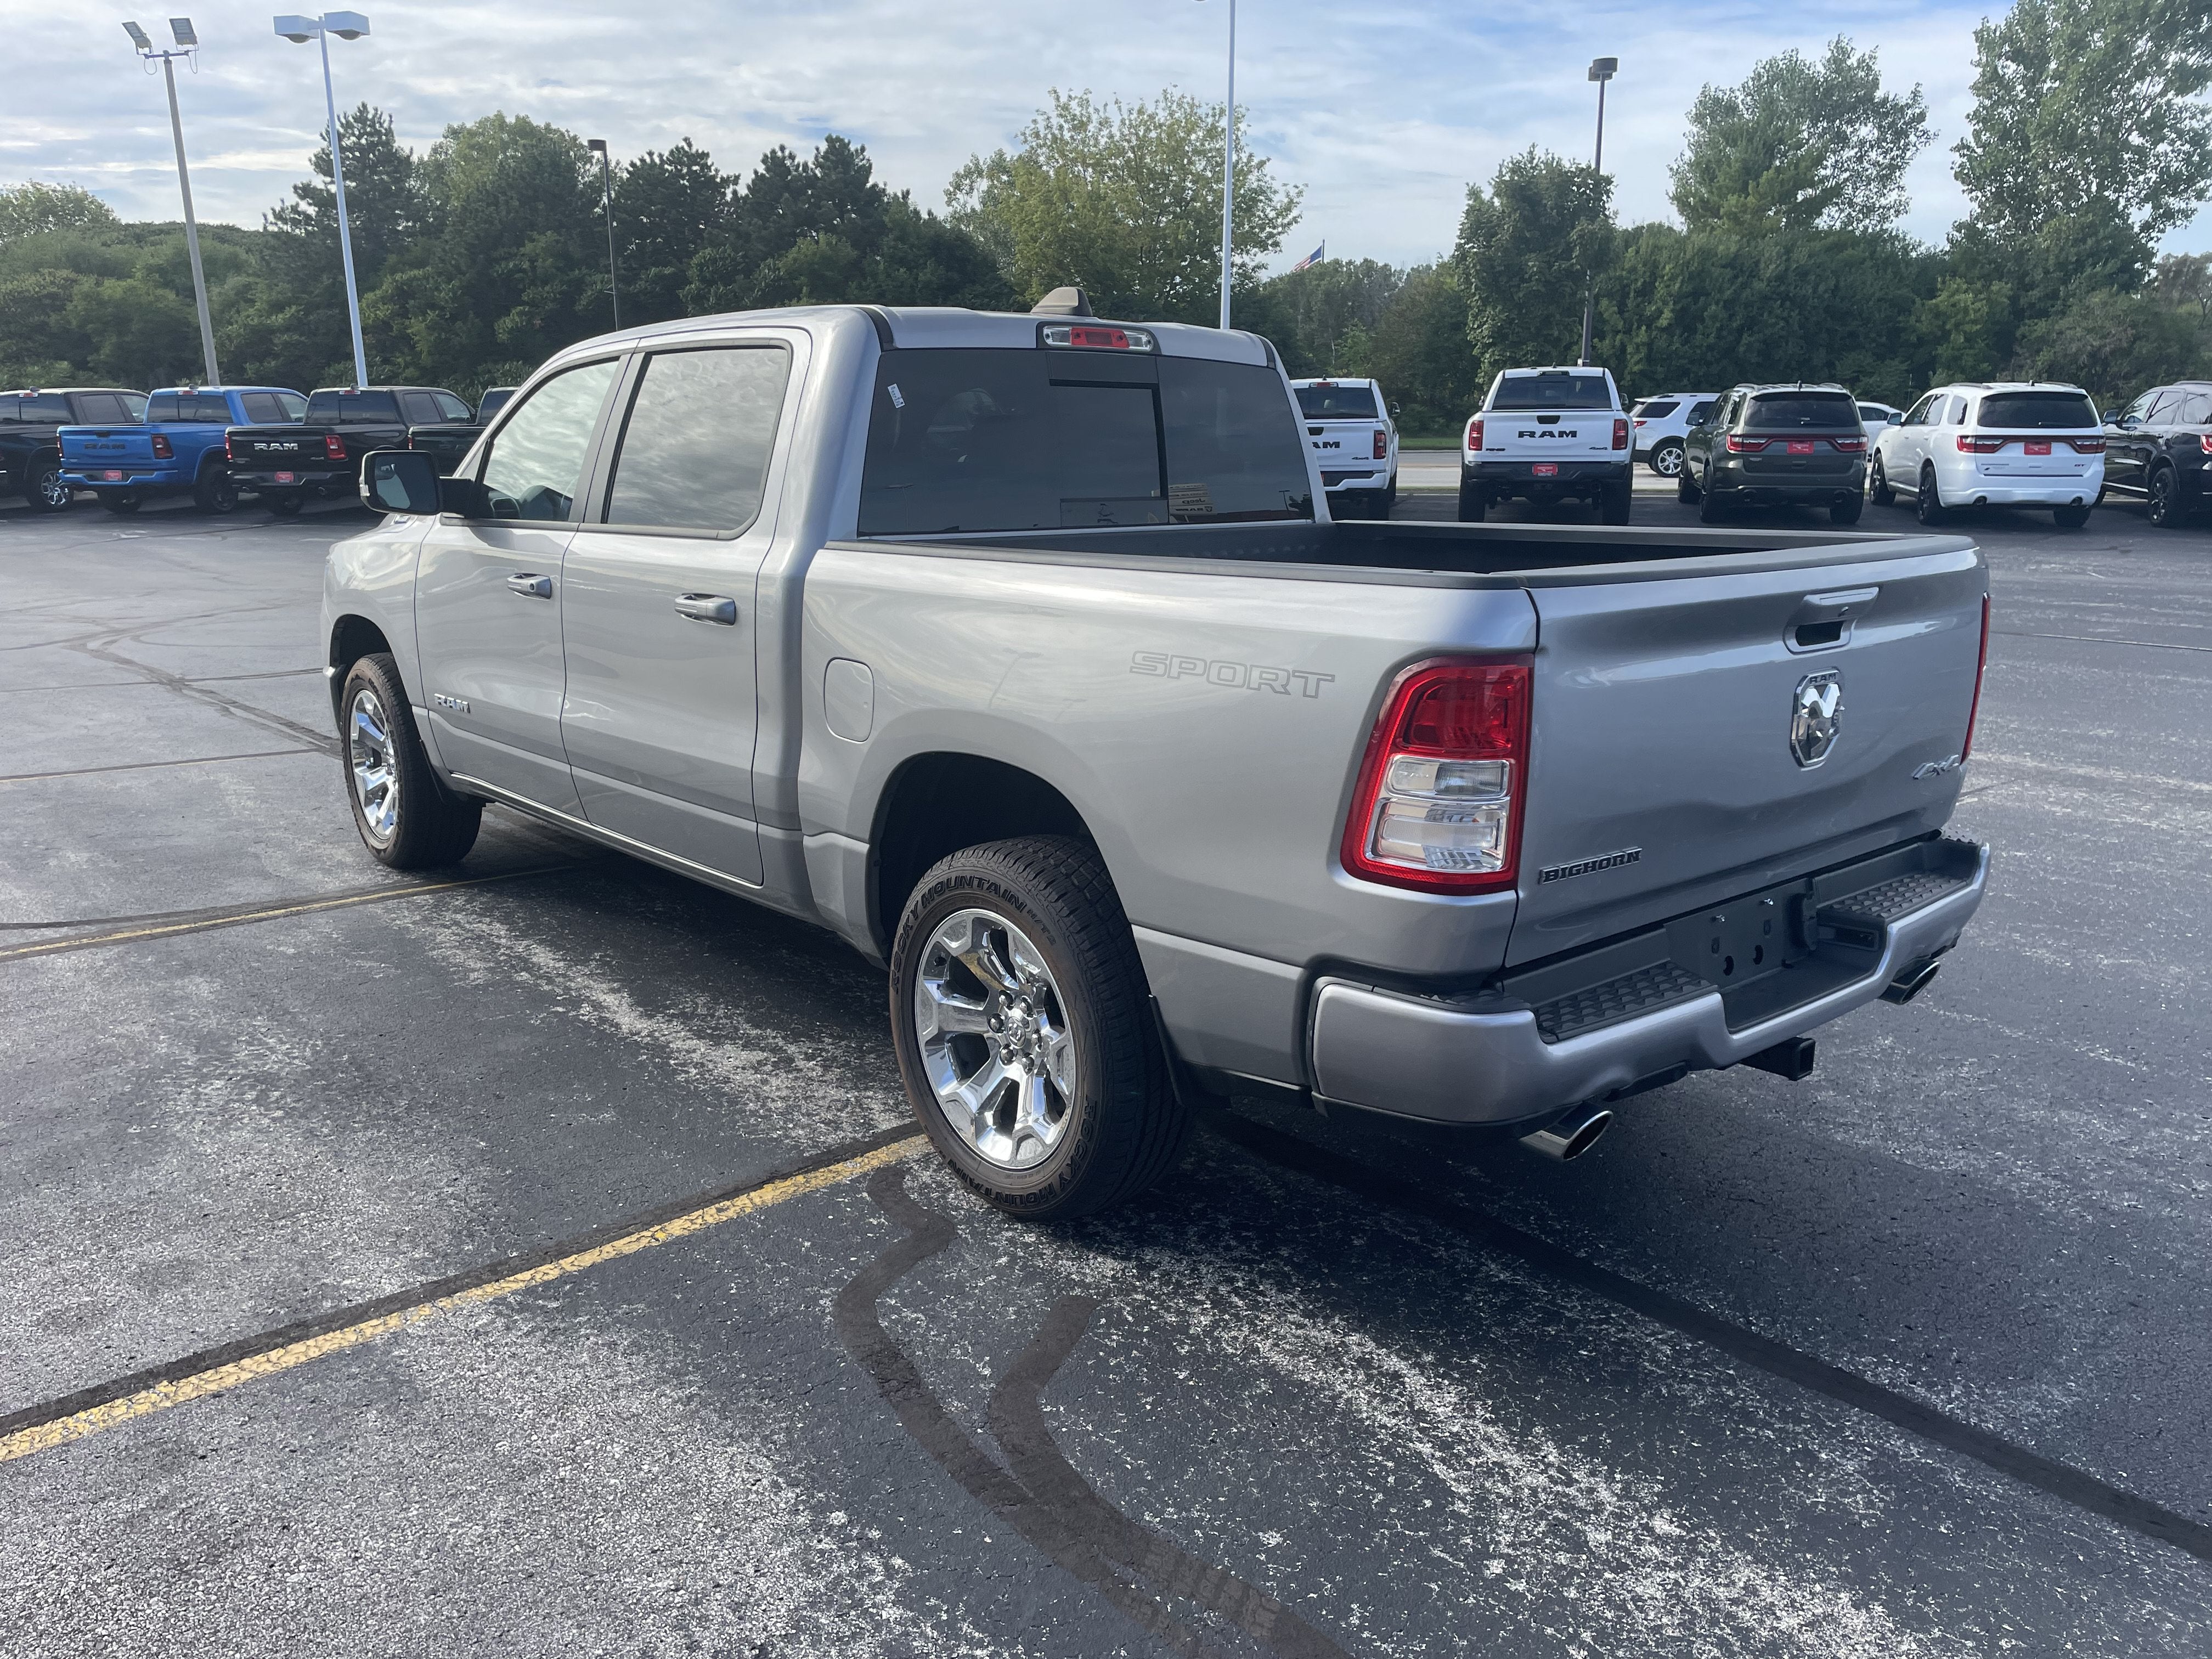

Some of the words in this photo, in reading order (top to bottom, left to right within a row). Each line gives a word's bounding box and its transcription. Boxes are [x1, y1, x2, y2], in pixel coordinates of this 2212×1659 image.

[1130, 650, 1335, 699] SPORT
[1809, 673, 1836, 685] RAM
[434, 693, 471, 714] RAM
[1911, 754, 1959, 780] 4x4
[1537, 847, 1643, 885] BIGHORN
[892, 901, 919, 994] ROCKY
[921, 875, 1028, 913] MOUNTAIN
[1058, 1094, 1097, 1190] ROCKY
[947, 1158, 1056, 1205] MOUNTAIN
